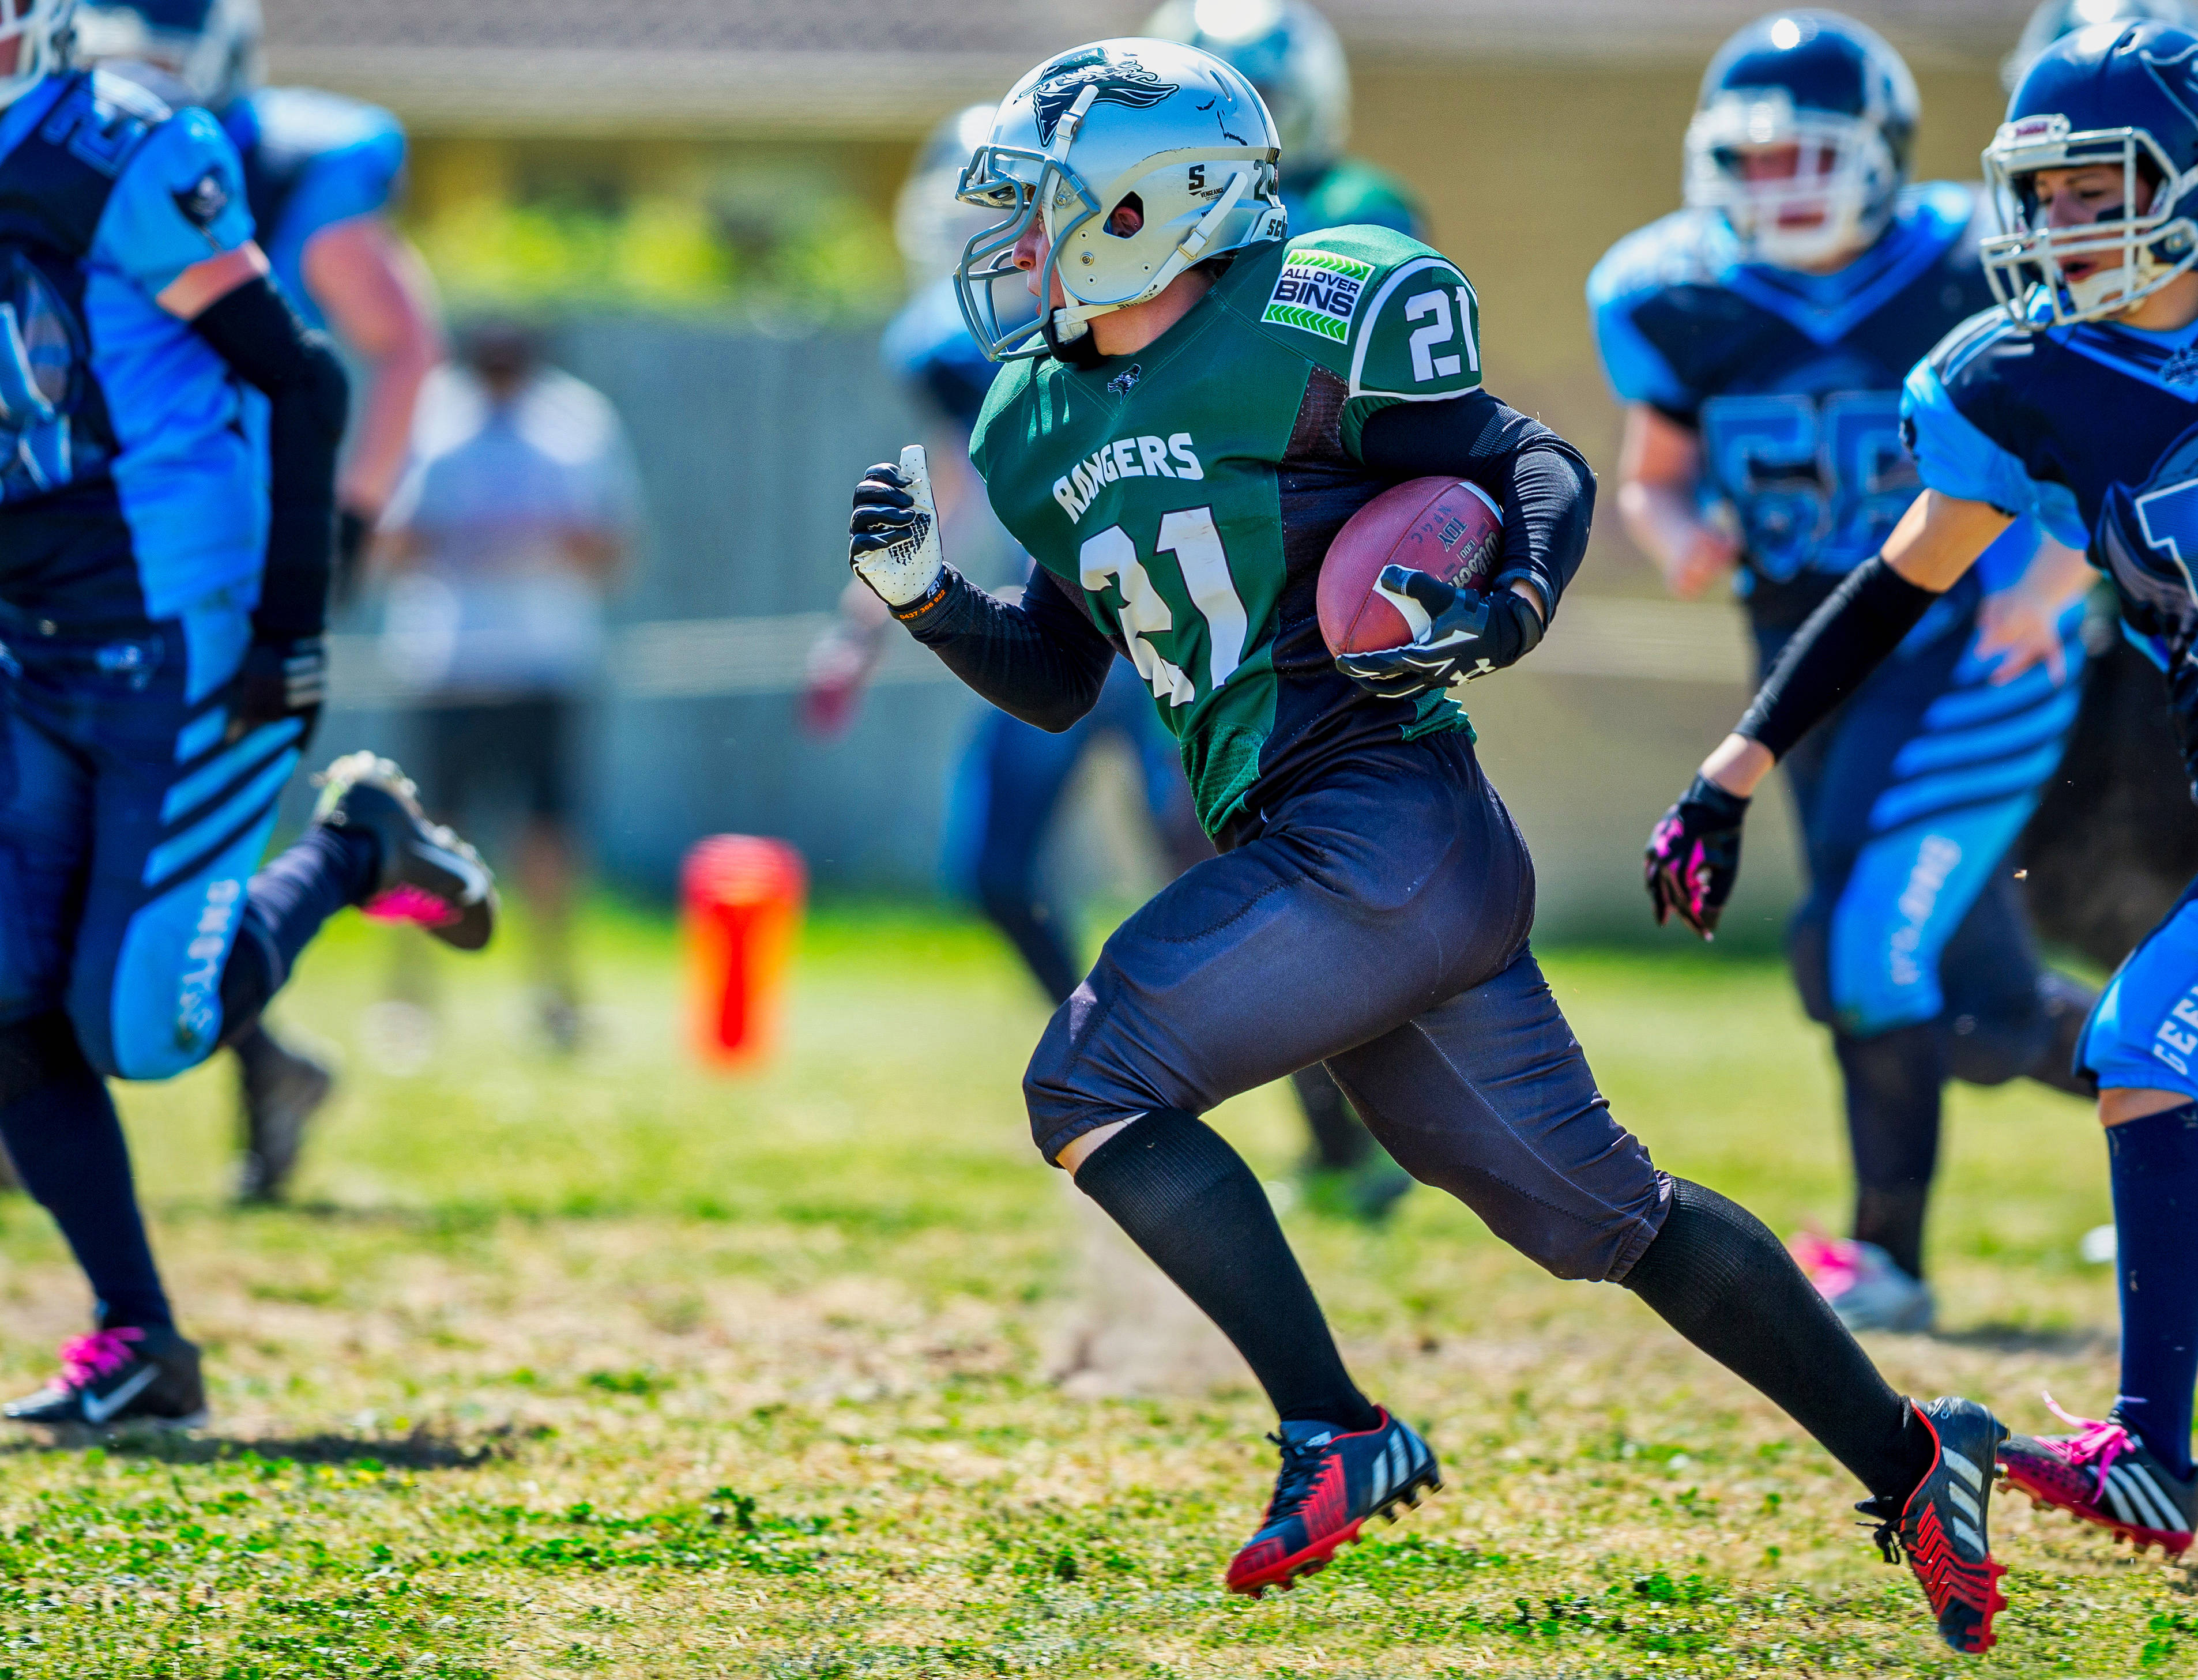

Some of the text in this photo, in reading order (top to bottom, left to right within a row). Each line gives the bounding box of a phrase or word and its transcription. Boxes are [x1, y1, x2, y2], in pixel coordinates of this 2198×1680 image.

[1188, 164, 1205, 191] S
[1273, 280, 1355, 317] BINS
[1281, 268, 1360, 295] ALL OVER
[1403, 285, 1480, 383] 21
[1052, 432, 1205, 525] RANGERS
[1436, 516, 1469, 553] TDY
[899, 611, 919, 620] 0437
[934, 589, 946, 603] 922
[1079, 503, 1250, 709] 21
